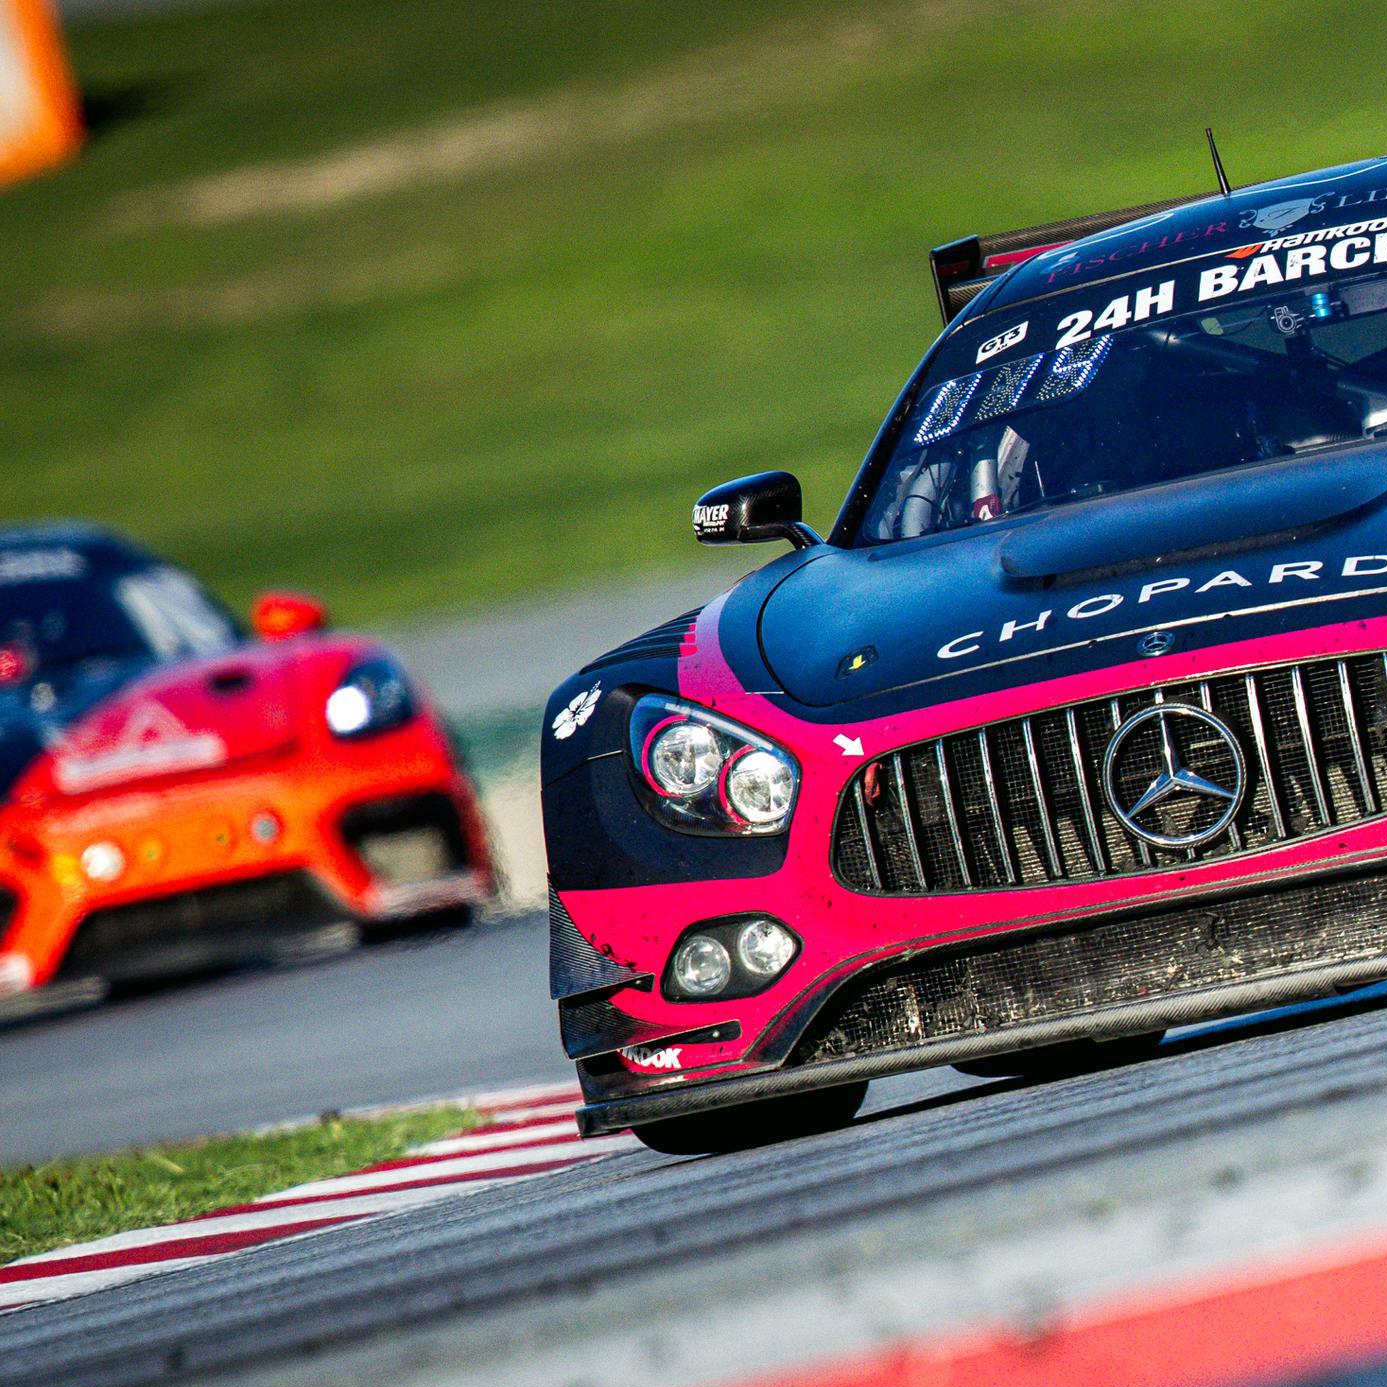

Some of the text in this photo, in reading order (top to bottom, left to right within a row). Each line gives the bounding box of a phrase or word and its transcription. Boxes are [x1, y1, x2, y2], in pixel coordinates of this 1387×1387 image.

[1055, 280, 1175, 350] 24H
[981, 326, 1021, 353] GT3
[693, 504, 729, 524] MAYER
